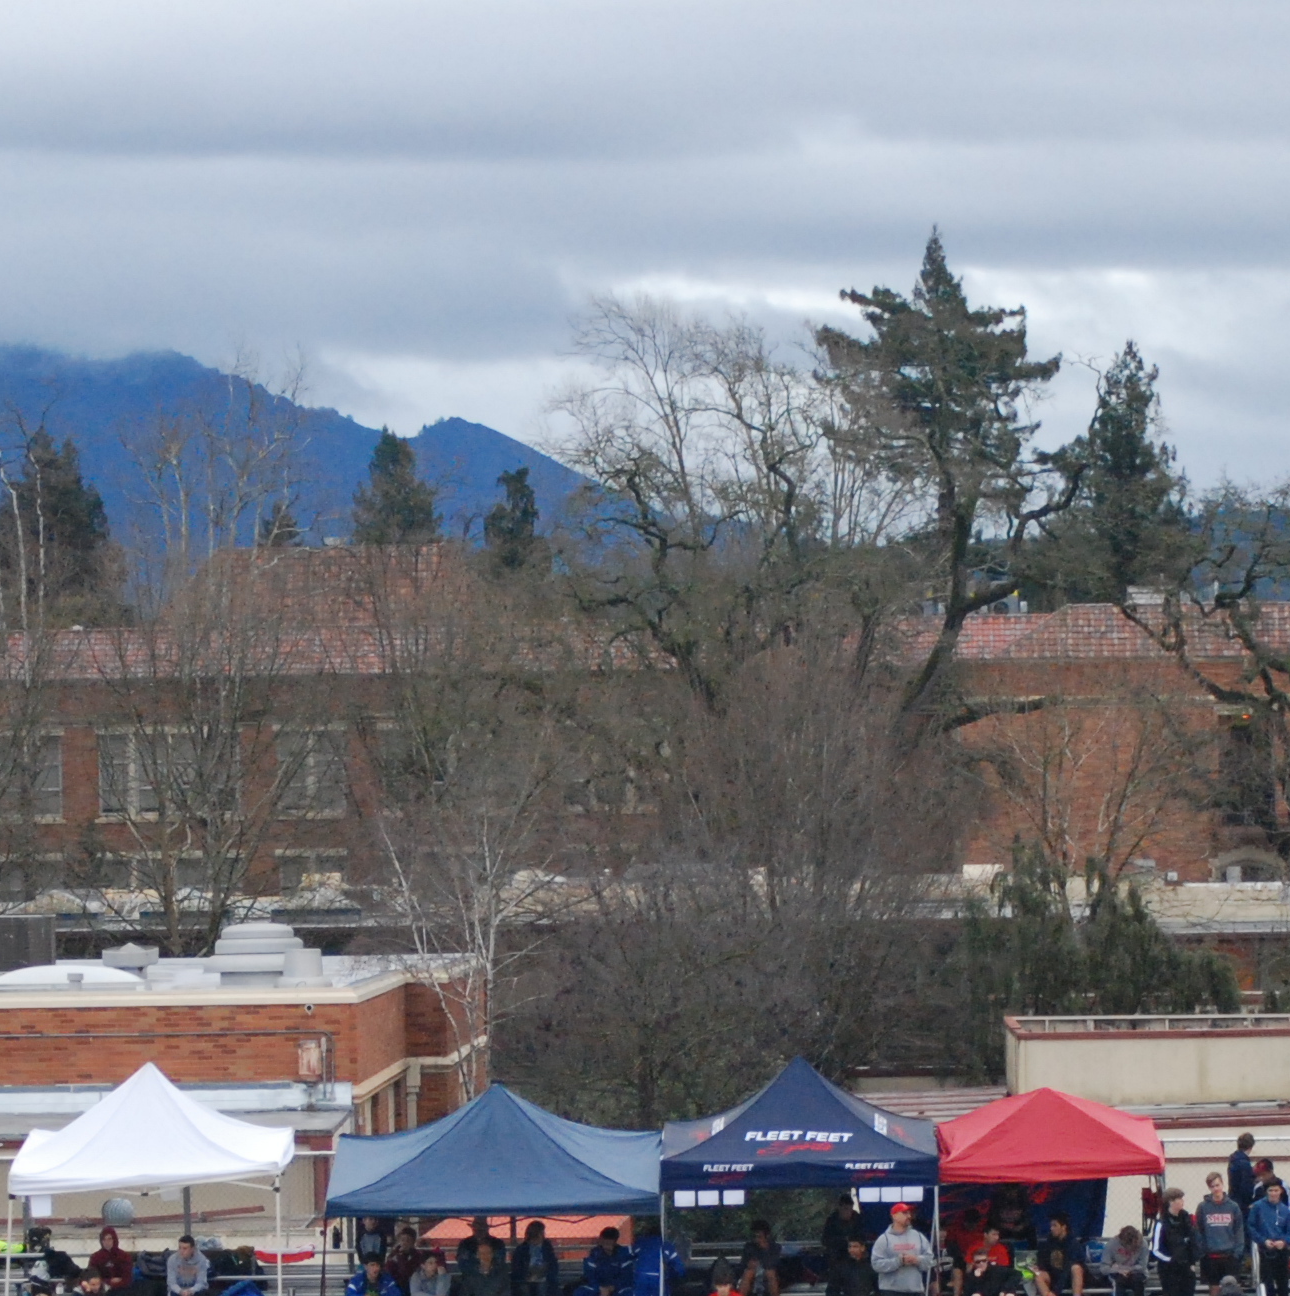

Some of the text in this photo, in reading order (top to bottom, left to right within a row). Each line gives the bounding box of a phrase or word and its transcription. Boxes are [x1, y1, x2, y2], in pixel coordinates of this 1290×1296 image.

[745, 1130, 854, 1143] FLEET FEET
[702, 1163, 755, 1172] FLEET FEET
[844, 1161, 896, 1170] FLEET FEET
